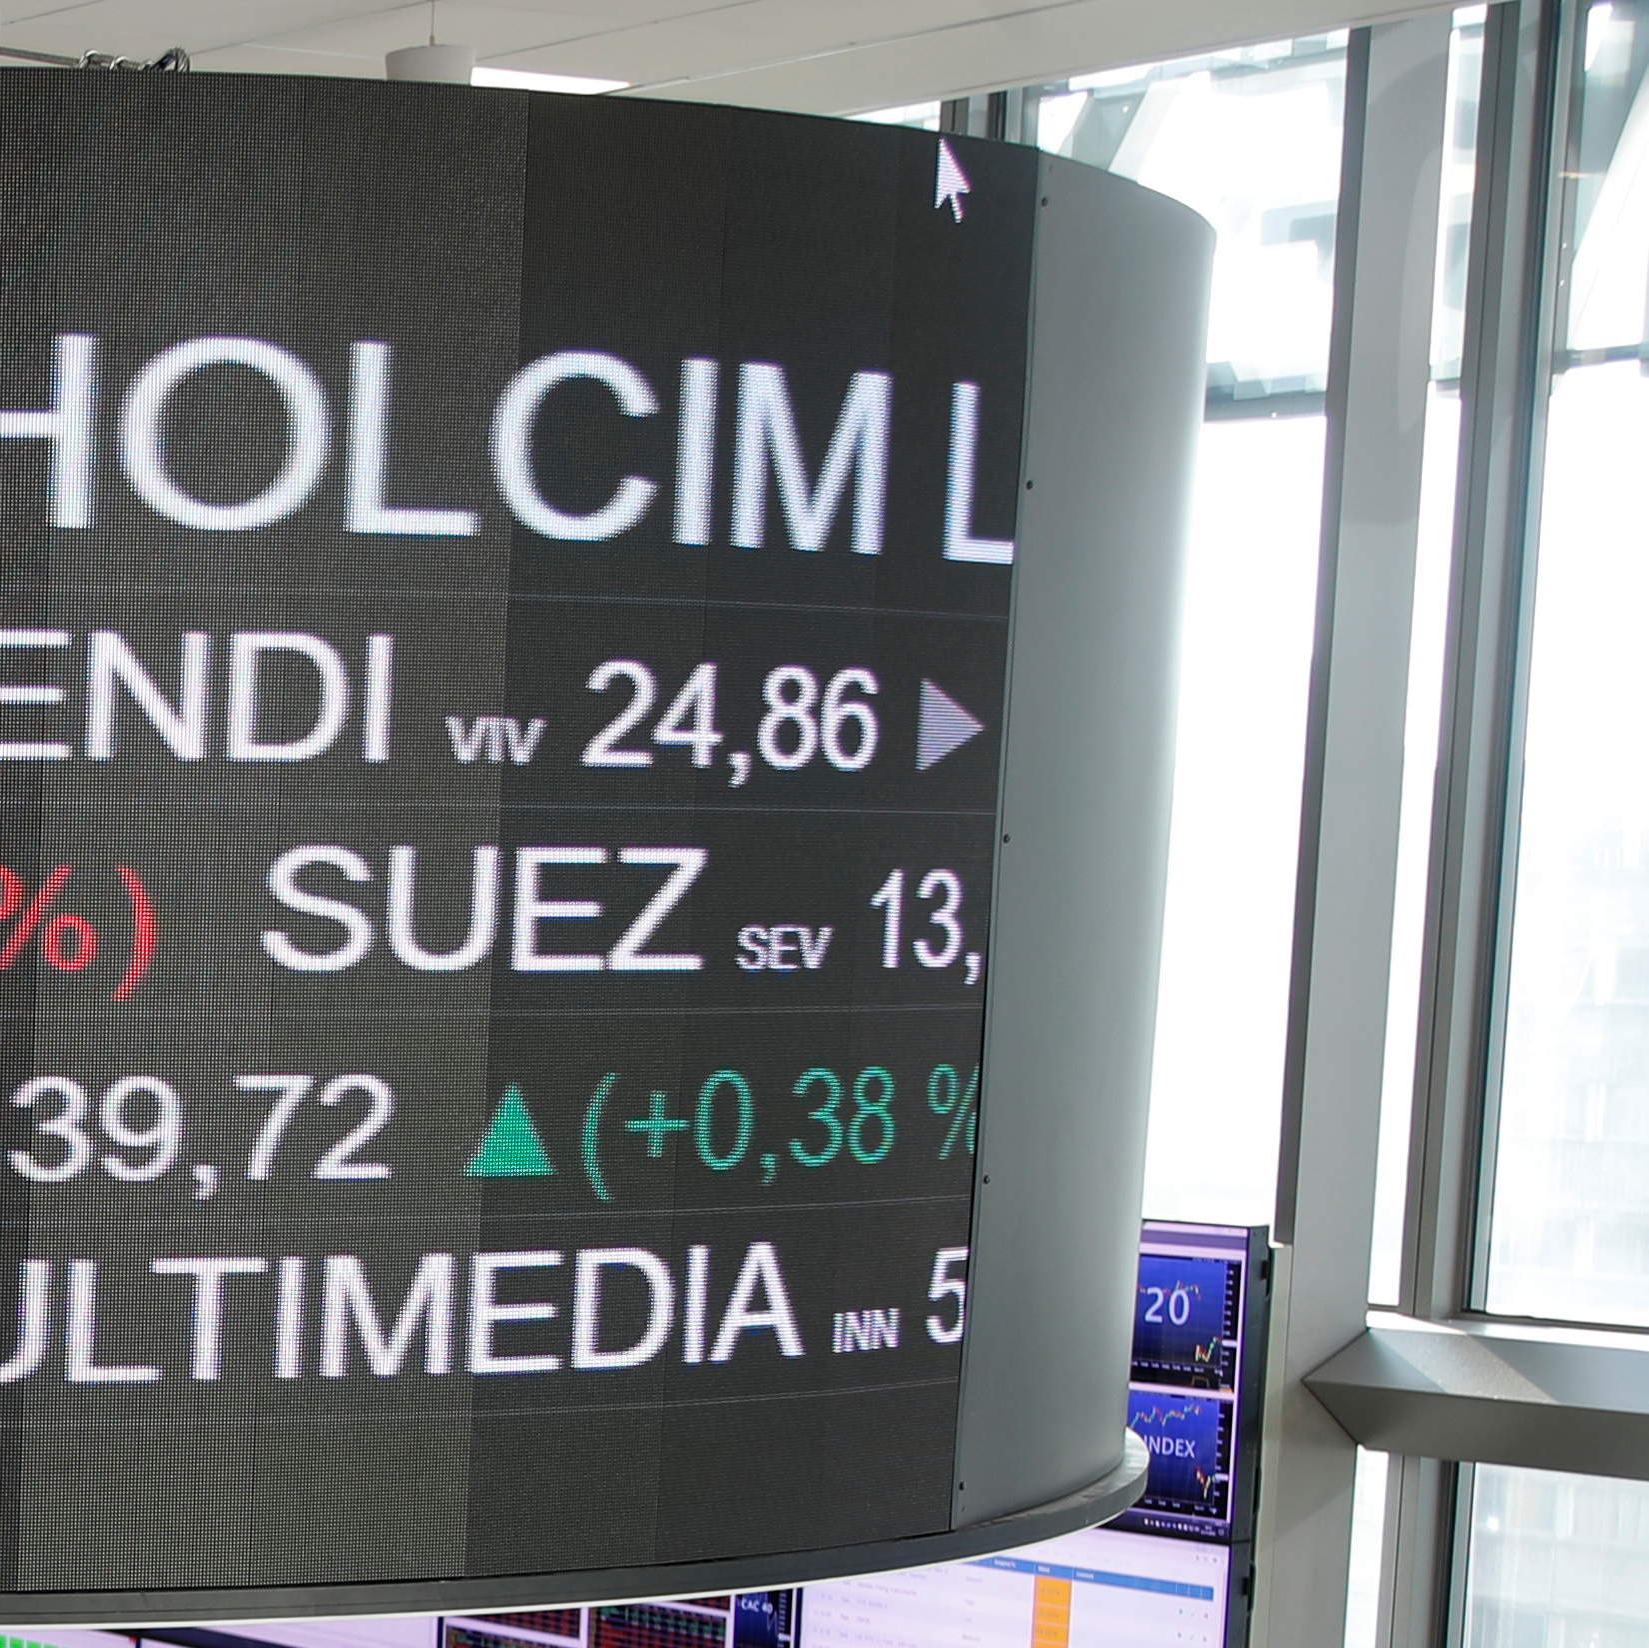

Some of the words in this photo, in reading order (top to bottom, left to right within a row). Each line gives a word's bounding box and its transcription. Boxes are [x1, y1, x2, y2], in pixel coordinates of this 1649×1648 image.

[944, 382, 1018, 565] L
[445, 716, 546, 765] VIV
[582, 660, 878, 786] 24,86
[260, 845, 707, 972] SUEZ
[737, 925, 832, 971] SEV
[8, 1074, 393, 1199] 39,72
[581, 1066, 895, 1200] (+0,38
[833, 1308, 899, 1353] INN
[1144, 1286, 1190, 1326] 20
